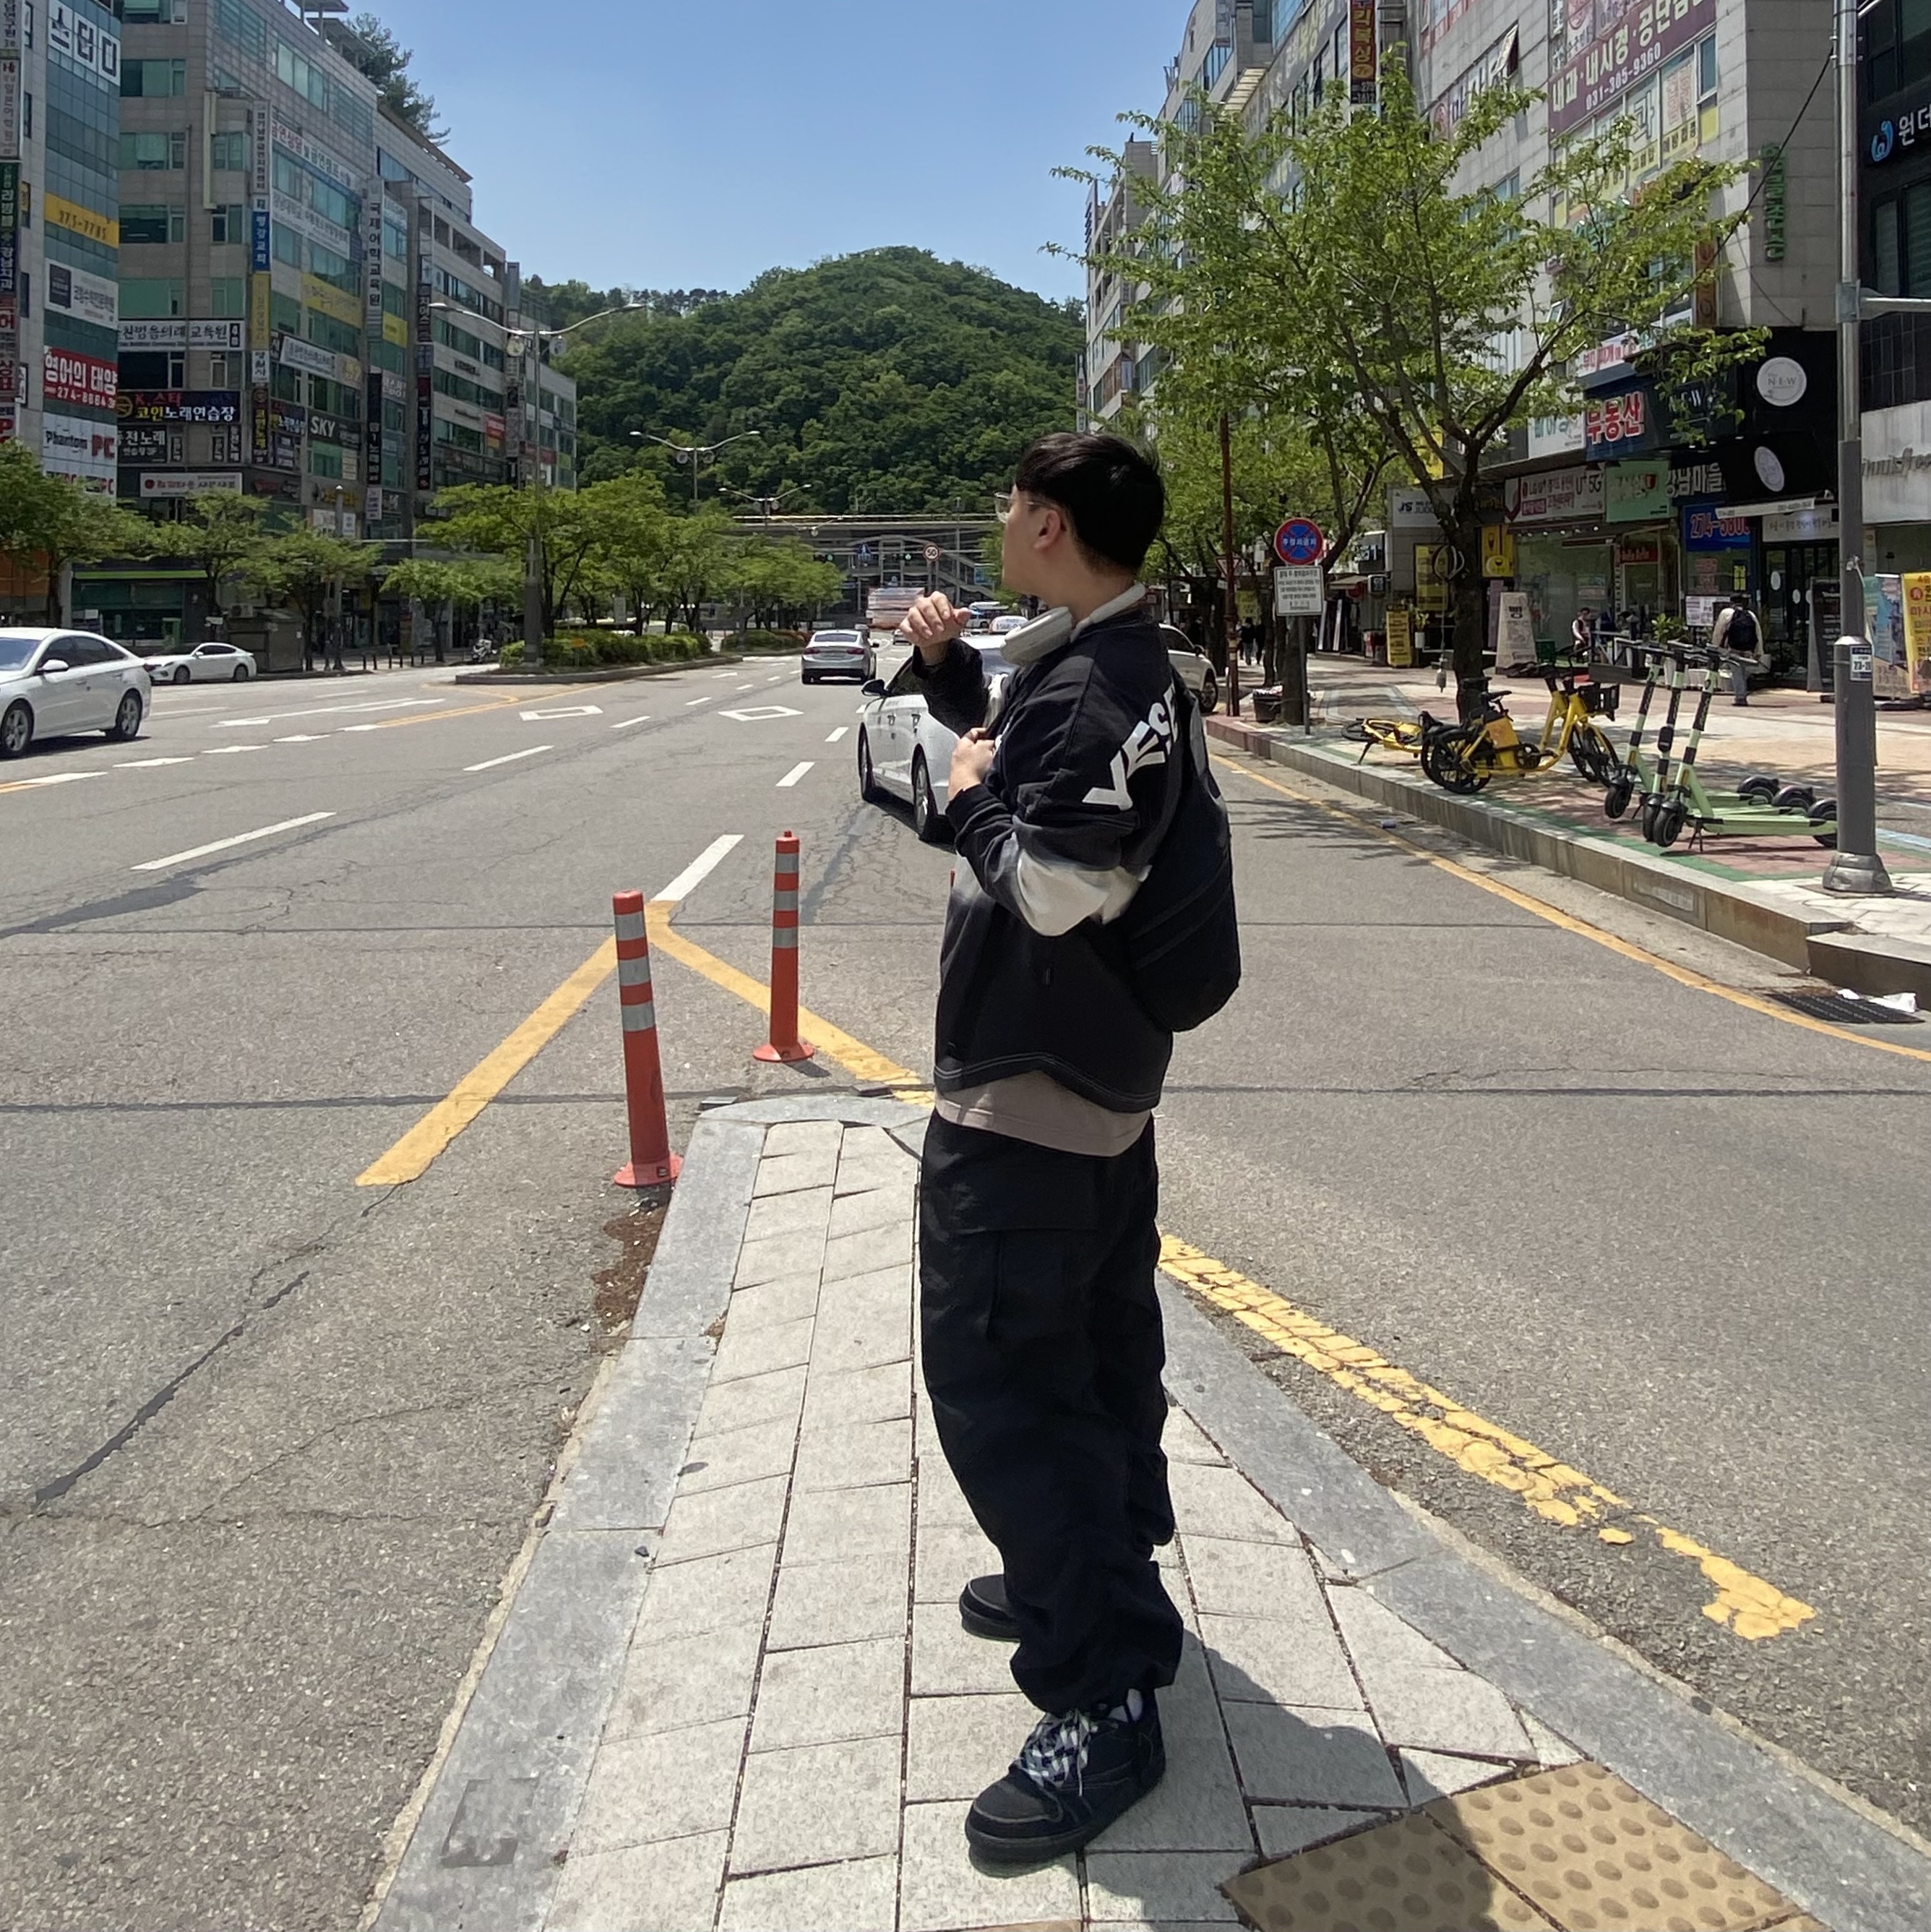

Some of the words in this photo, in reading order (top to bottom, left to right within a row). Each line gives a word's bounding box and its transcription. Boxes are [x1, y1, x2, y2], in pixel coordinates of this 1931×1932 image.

[45, 351, 87, 390] 영어의
[91, 365, 119, 396] 태양
[310, 416, 336, 438] SKY
[1586, 391, 1645, 445] 부동산
[92, 434, 115, 458] PC
[1665, 463, 1724, 498] 강남마을
[926, 548, 937, 557] 50
